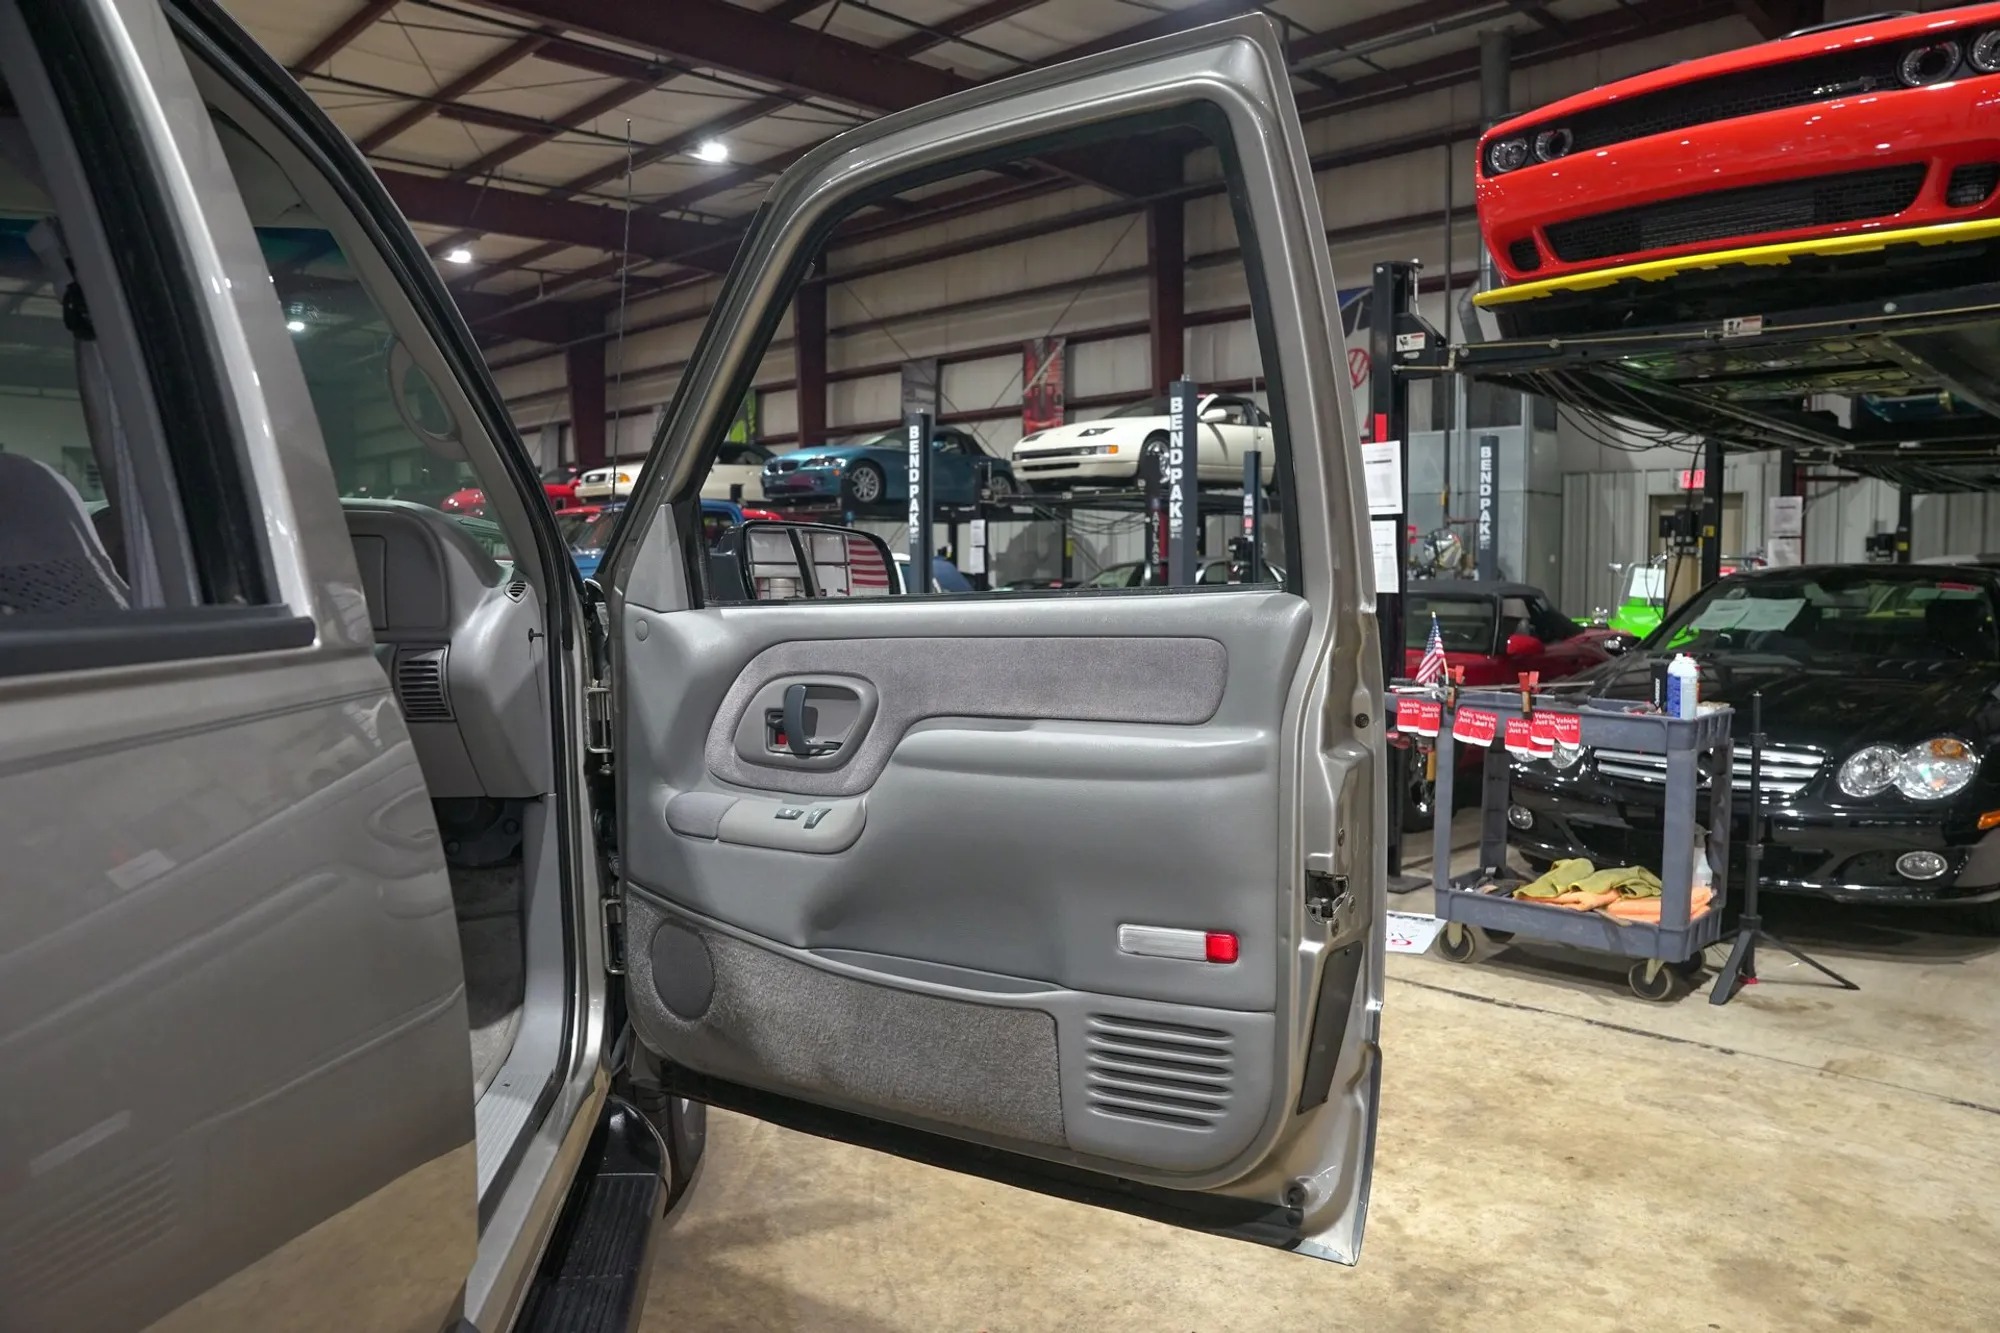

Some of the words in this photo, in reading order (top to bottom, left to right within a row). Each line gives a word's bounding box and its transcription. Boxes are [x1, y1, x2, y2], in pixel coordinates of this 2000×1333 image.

[908, 425, 920, 527] BENDPAK
[1169, 396, 1184, 518] BENDPAK
[1480, 446, 1492, 535] BENDPAK
[1151, 511, 1160, 564] ATLAS
[1399, 702, 1420, 710] Vehicle
[1475, 713, 1497, 723] Vehicle
